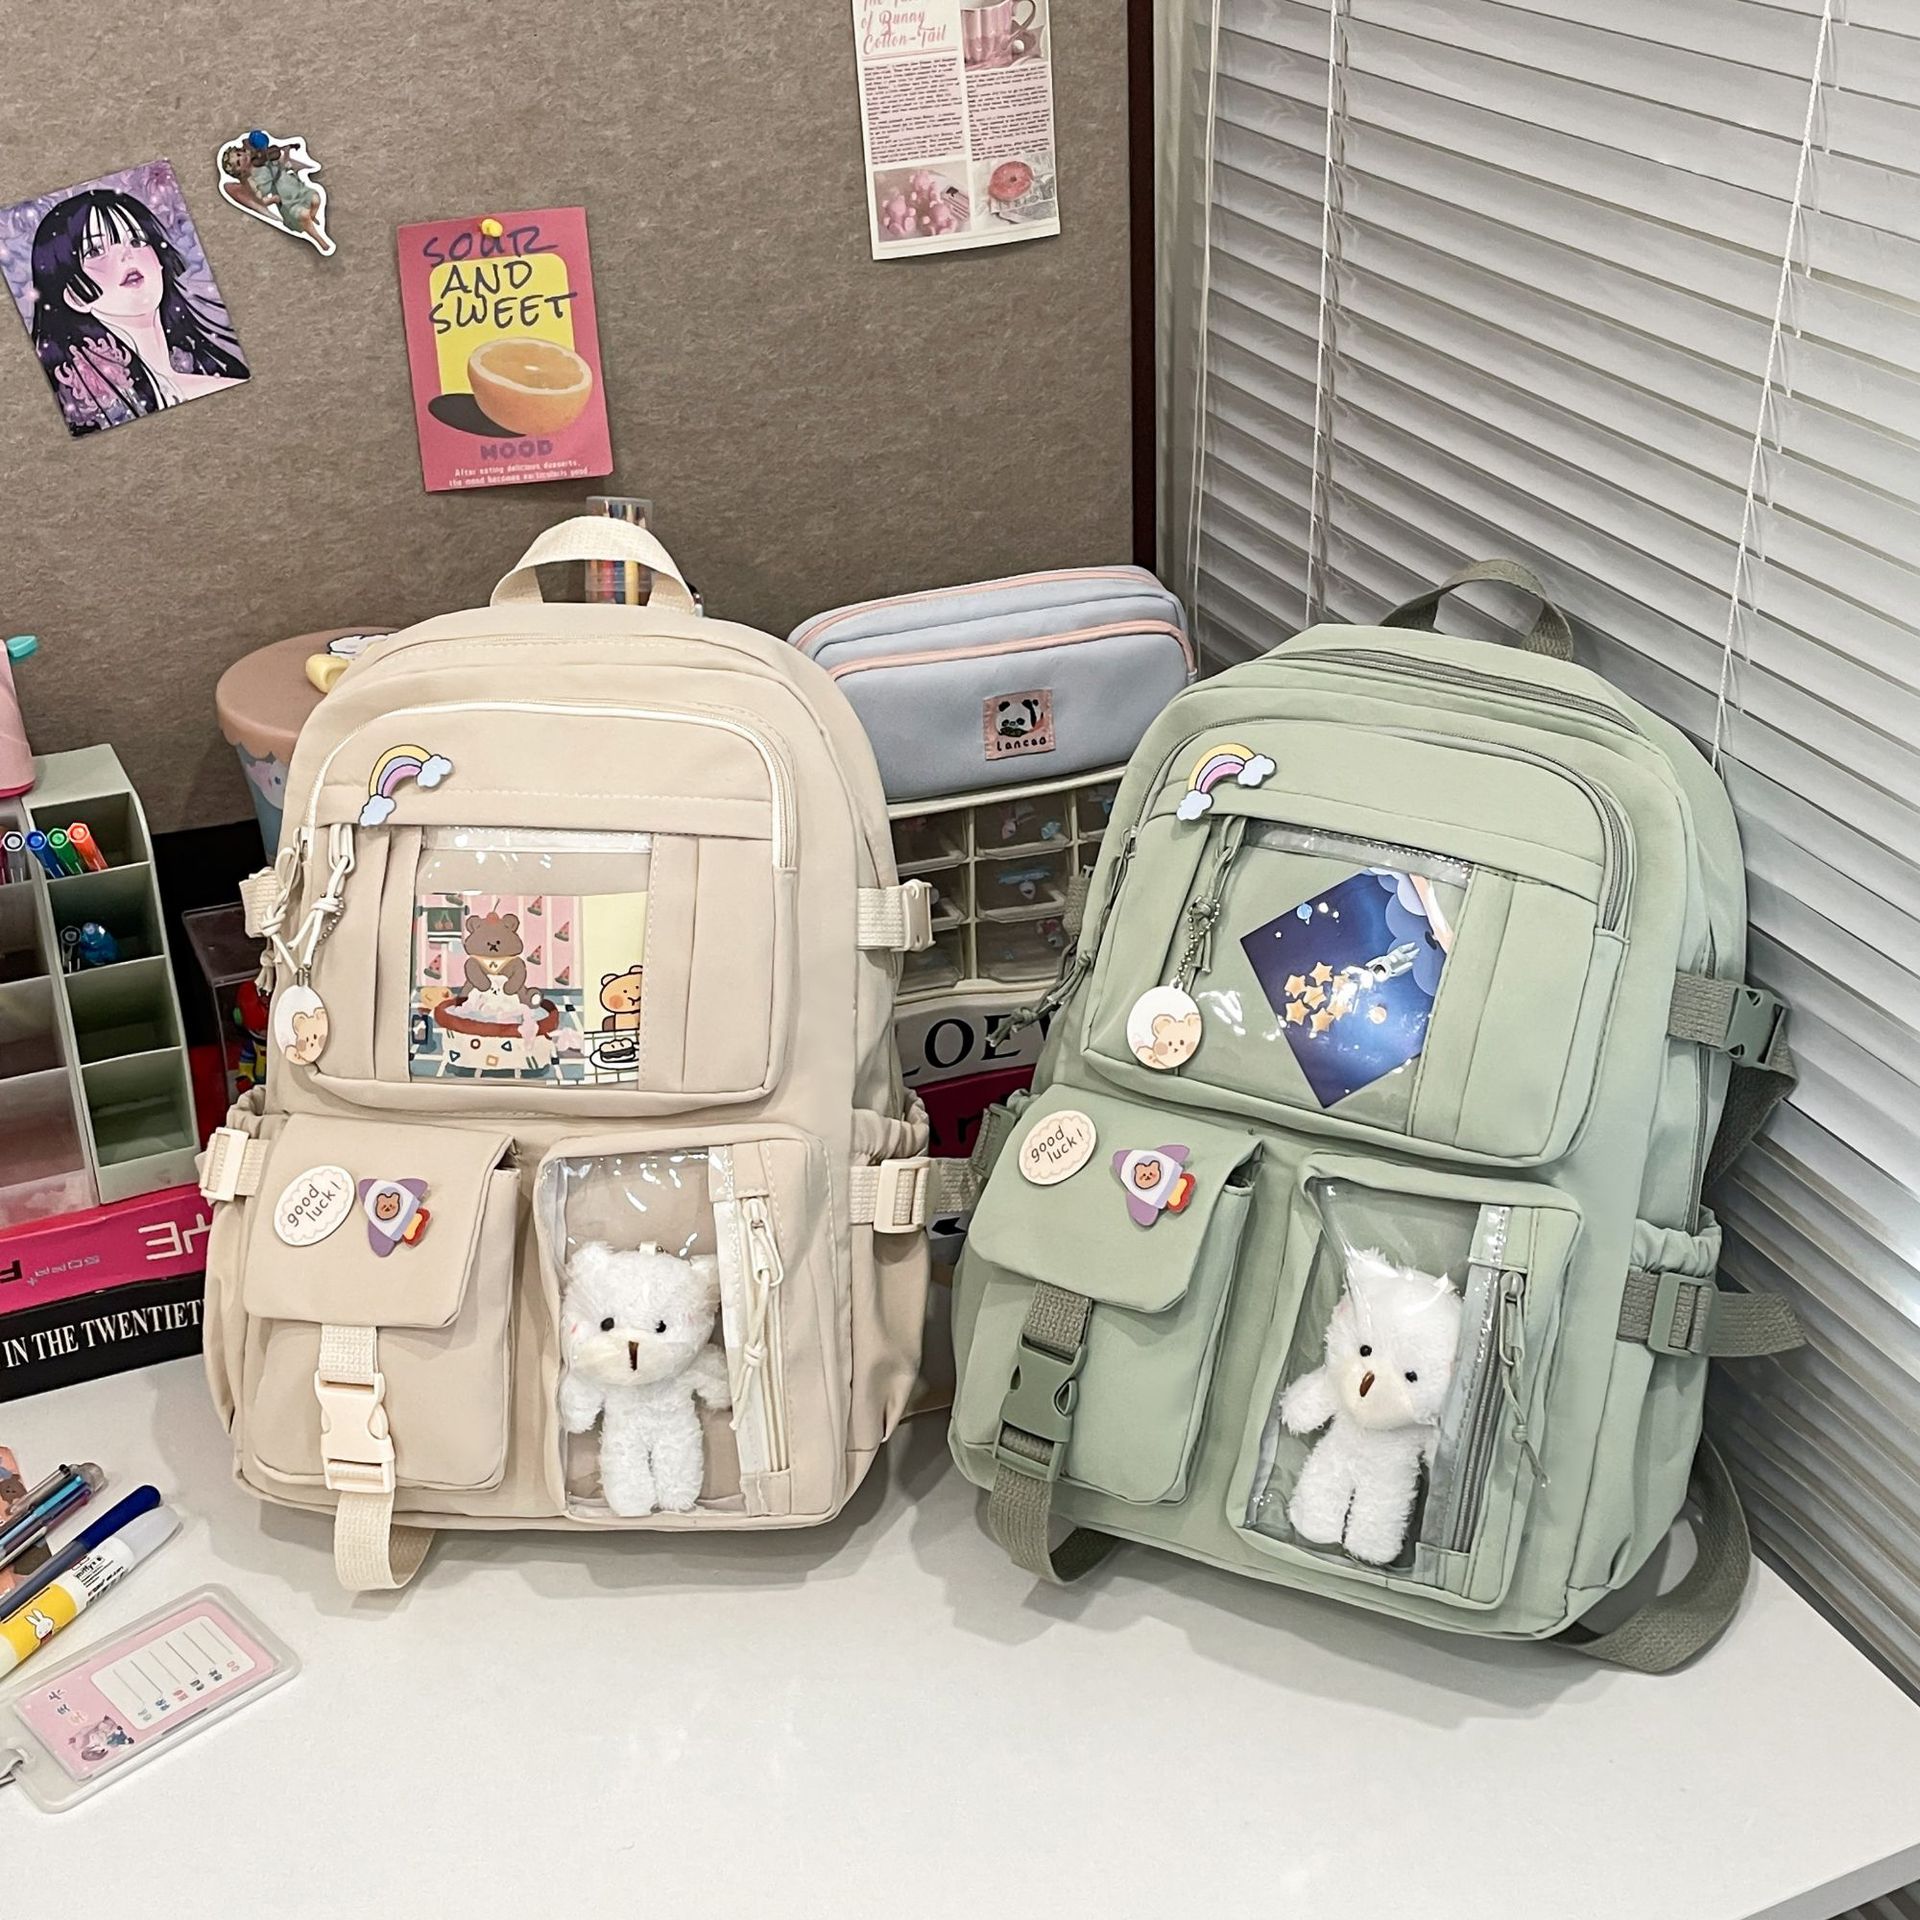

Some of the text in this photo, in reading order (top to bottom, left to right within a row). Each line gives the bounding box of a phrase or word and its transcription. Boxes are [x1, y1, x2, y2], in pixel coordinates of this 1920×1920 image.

[880, 10, 926, 37] Bunny
[423, 226, 559, 268] SOUR
[440, 260, 533, 299] AND
[428, 292, 578, 335] SWEET
[480, 440, 553, 460] MOOD
[1031, 1125, 1065, 1163] good
[287, 1183, 320, 1228] good
[2, 1299, 204, 1368] IN THE TWENTIET
